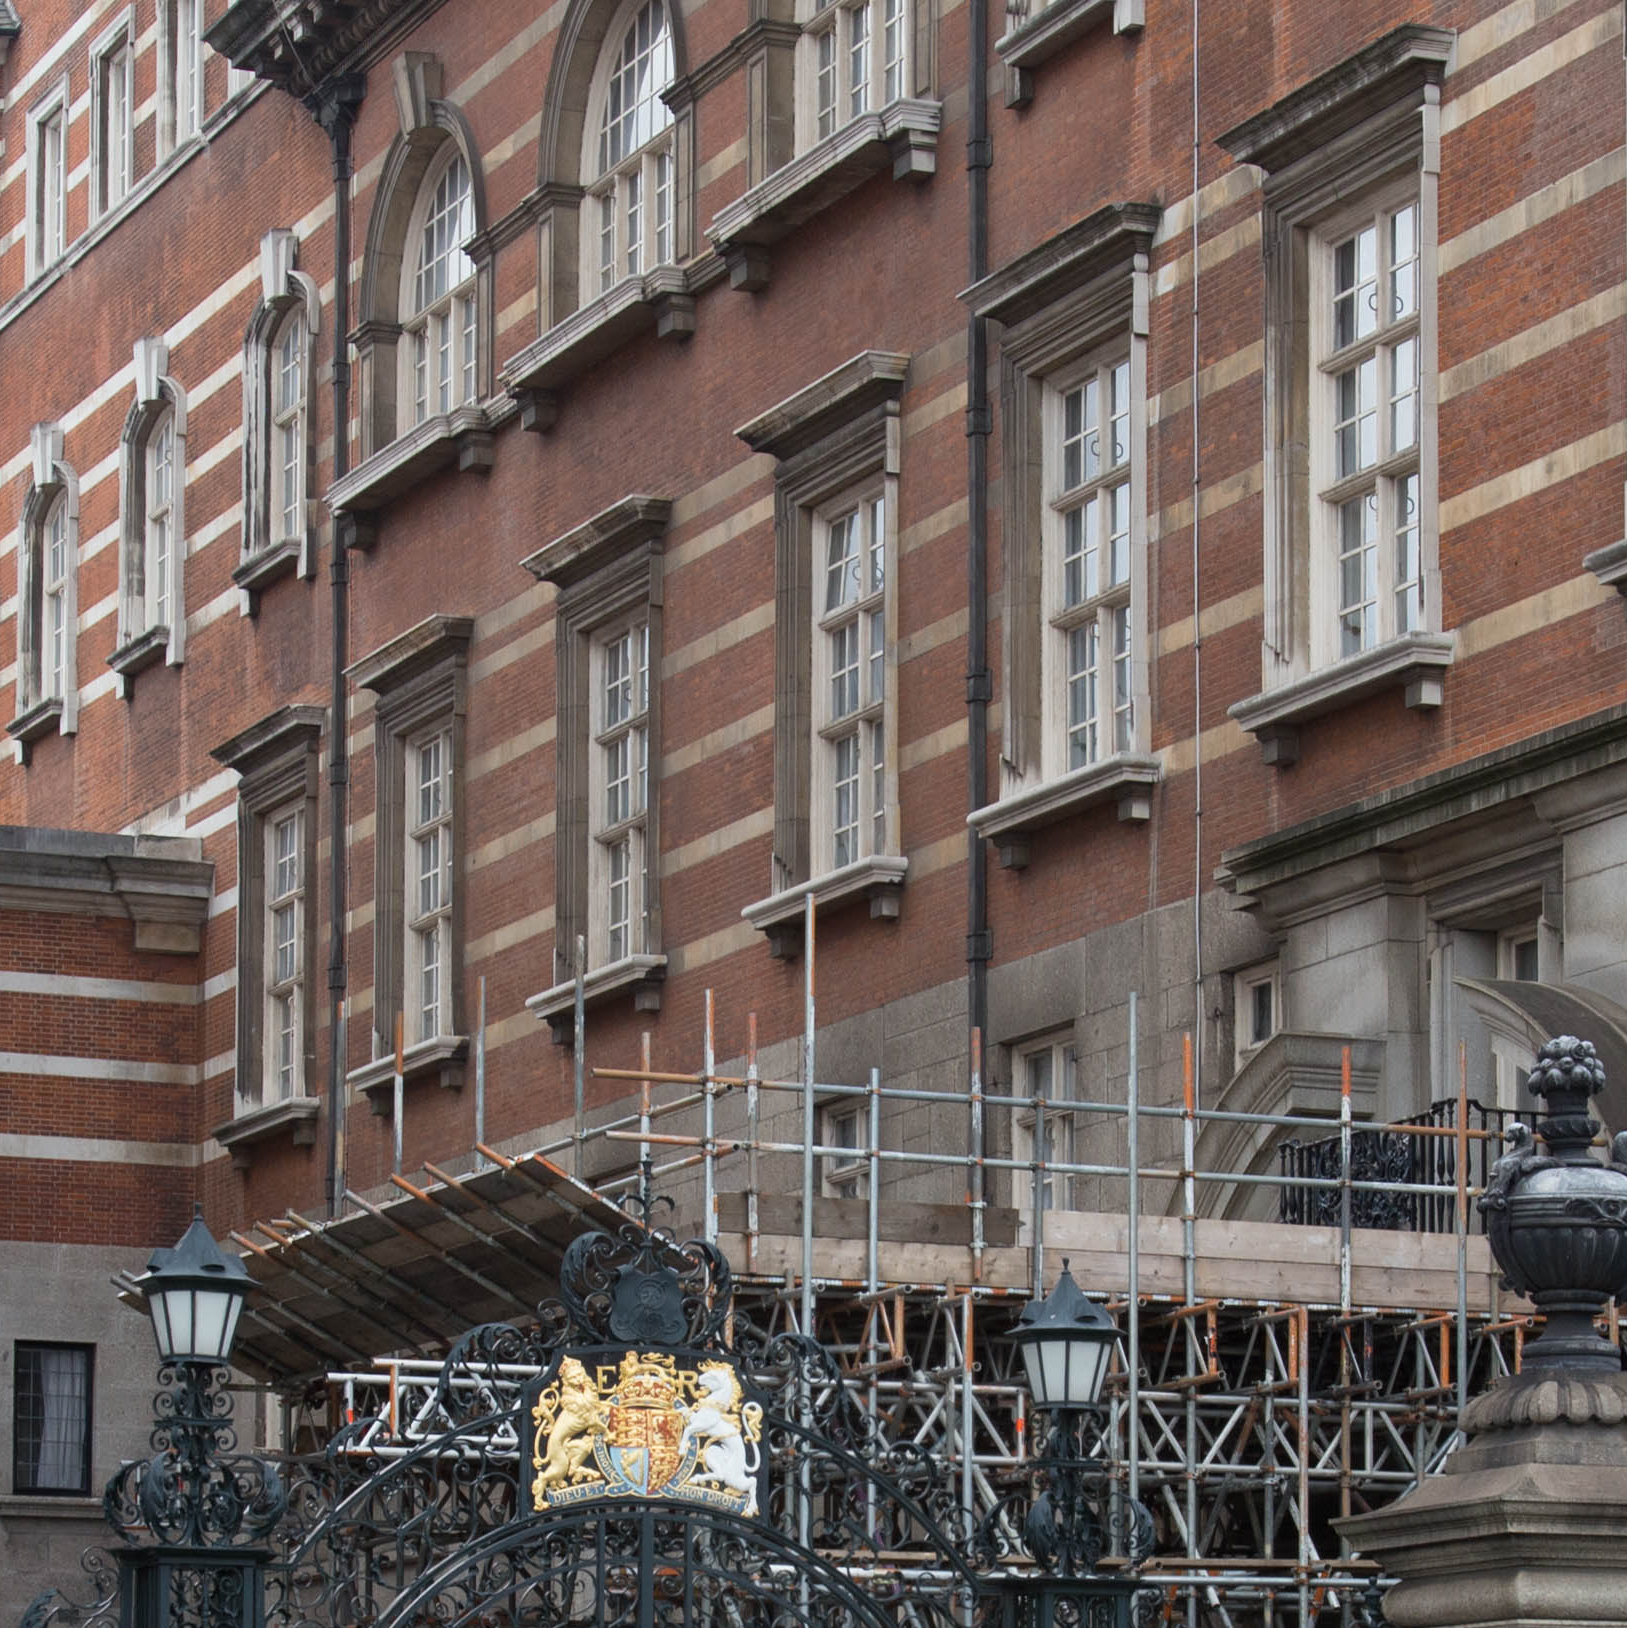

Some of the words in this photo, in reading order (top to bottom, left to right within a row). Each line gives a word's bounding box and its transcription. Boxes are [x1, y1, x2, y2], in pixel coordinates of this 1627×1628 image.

[596, 1365, 617, 1394] E
[678, 1370, 701, 1398] R
[553, 1487, 581, 1503] DIEU
[585, 1483, 600, 1496] ET
[707, 1491, 745, 1508] DROIT
